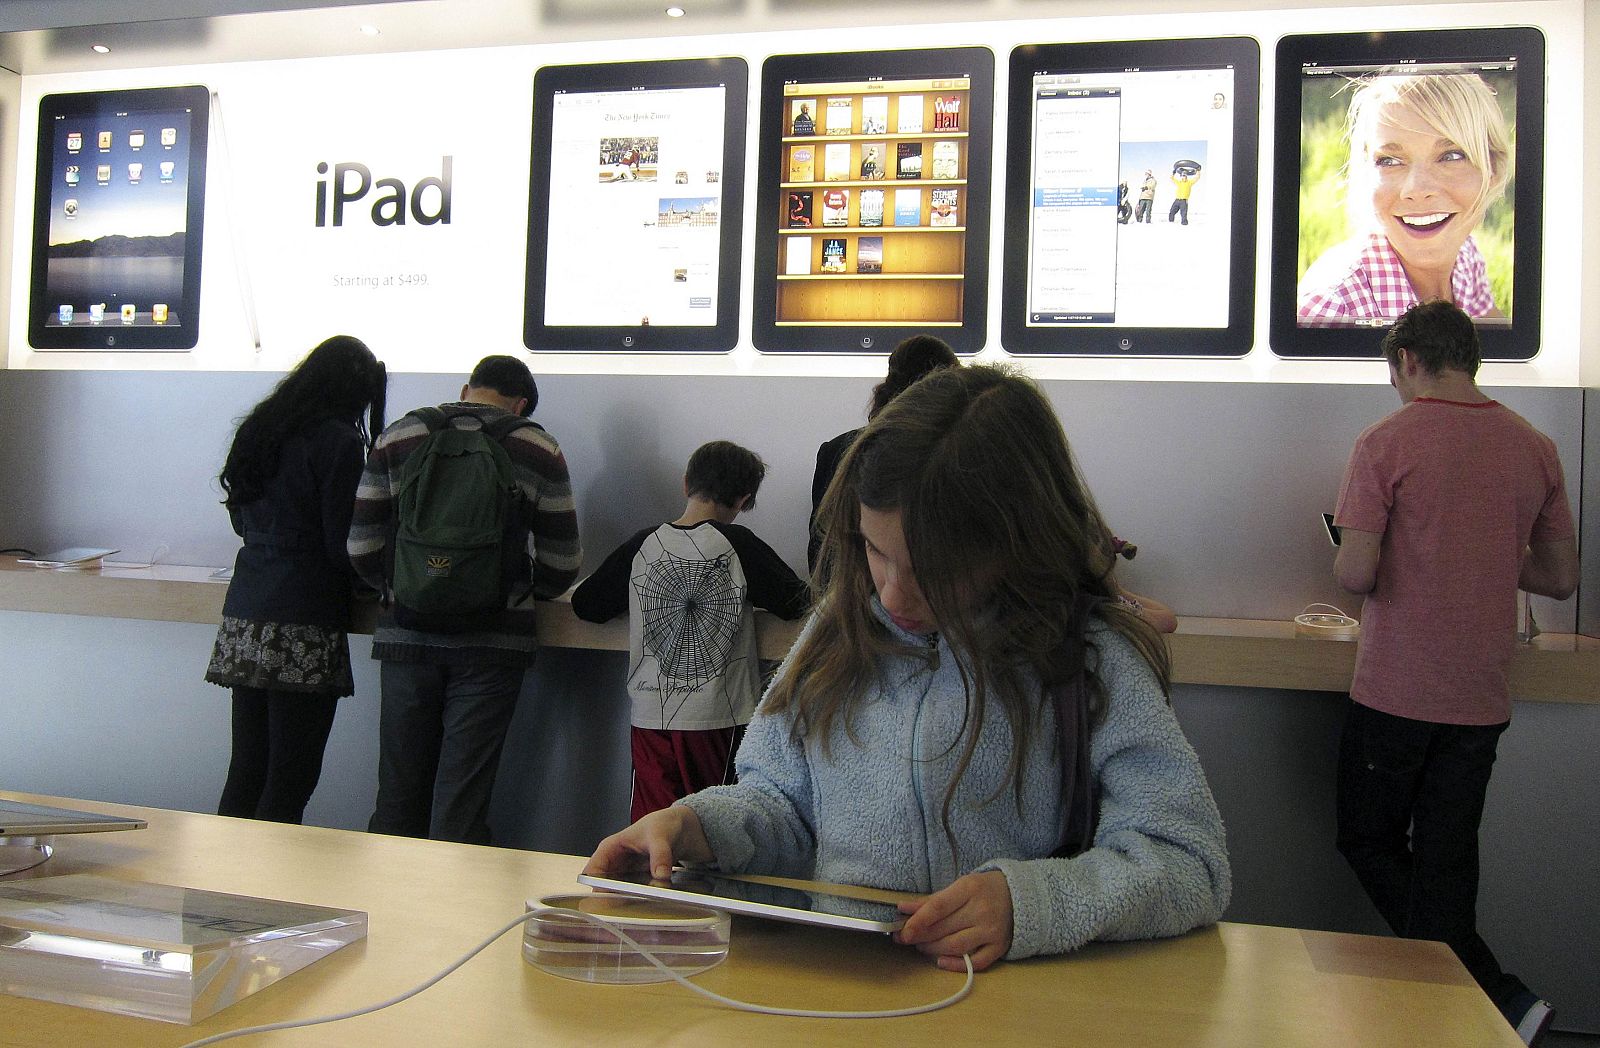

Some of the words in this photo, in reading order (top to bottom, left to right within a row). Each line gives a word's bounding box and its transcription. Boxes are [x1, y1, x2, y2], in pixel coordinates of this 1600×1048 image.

[934, 101, 960, 113] Wolf
[604, 113, 616, 122] The
[617, 113, 632, 121] New
[632, 112, 649, 123] York
[650, 112, 671, 121] Times
[934, 113, 960, 128] Hall
[69, 139, 80, 147] 27
[315, 155, 453, 227] iPad
[333, 273, 380, 290] Starting
[382, 274, 395, 286] at
